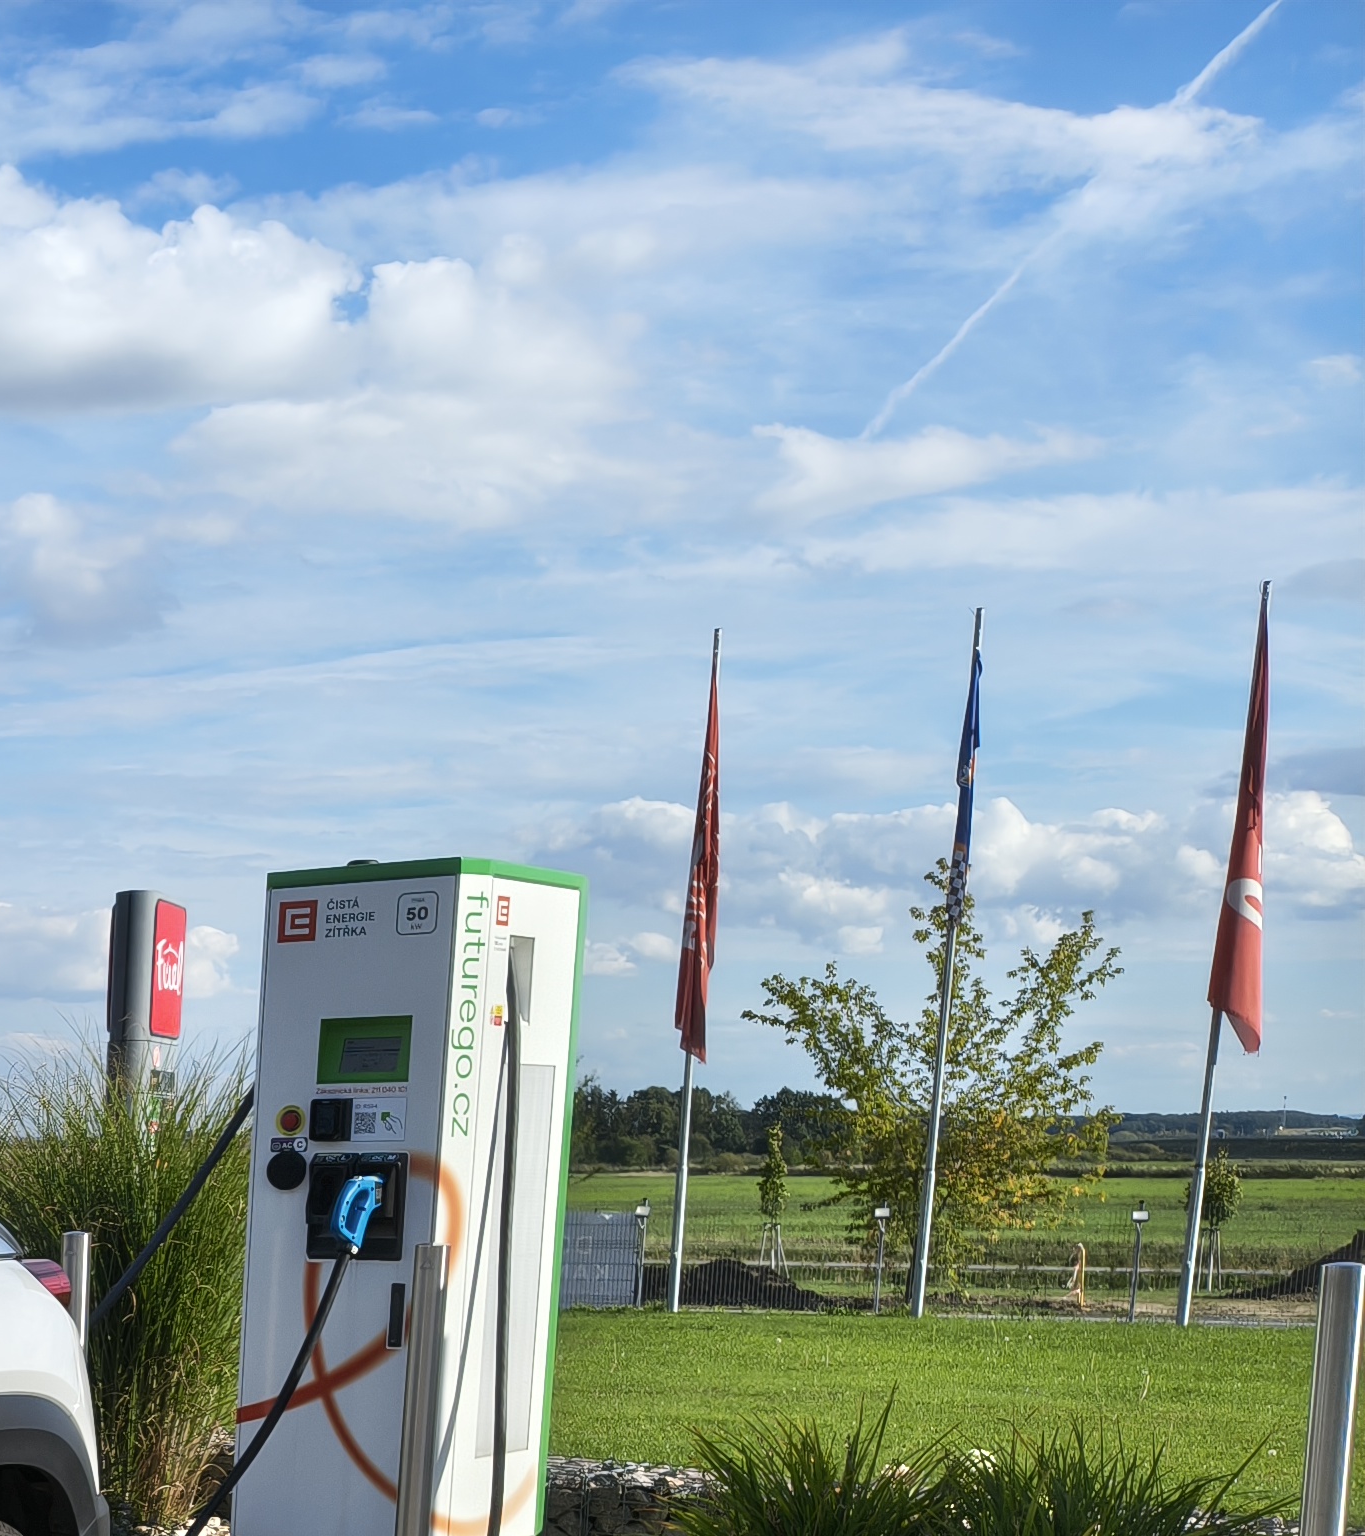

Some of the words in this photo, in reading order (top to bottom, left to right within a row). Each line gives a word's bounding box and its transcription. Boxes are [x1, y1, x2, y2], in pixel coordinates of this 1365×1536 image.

[326, 896, 360, 910] ČISTÁ
[325, 911, 376, 924] ENERGIE
[406, 906, 429, 921] 50
[324, 925, 367, 938] ZÍTŘKA
[451, 891, 489, 1137] futurego.cz
[296, 1141, 304, 1149] C
